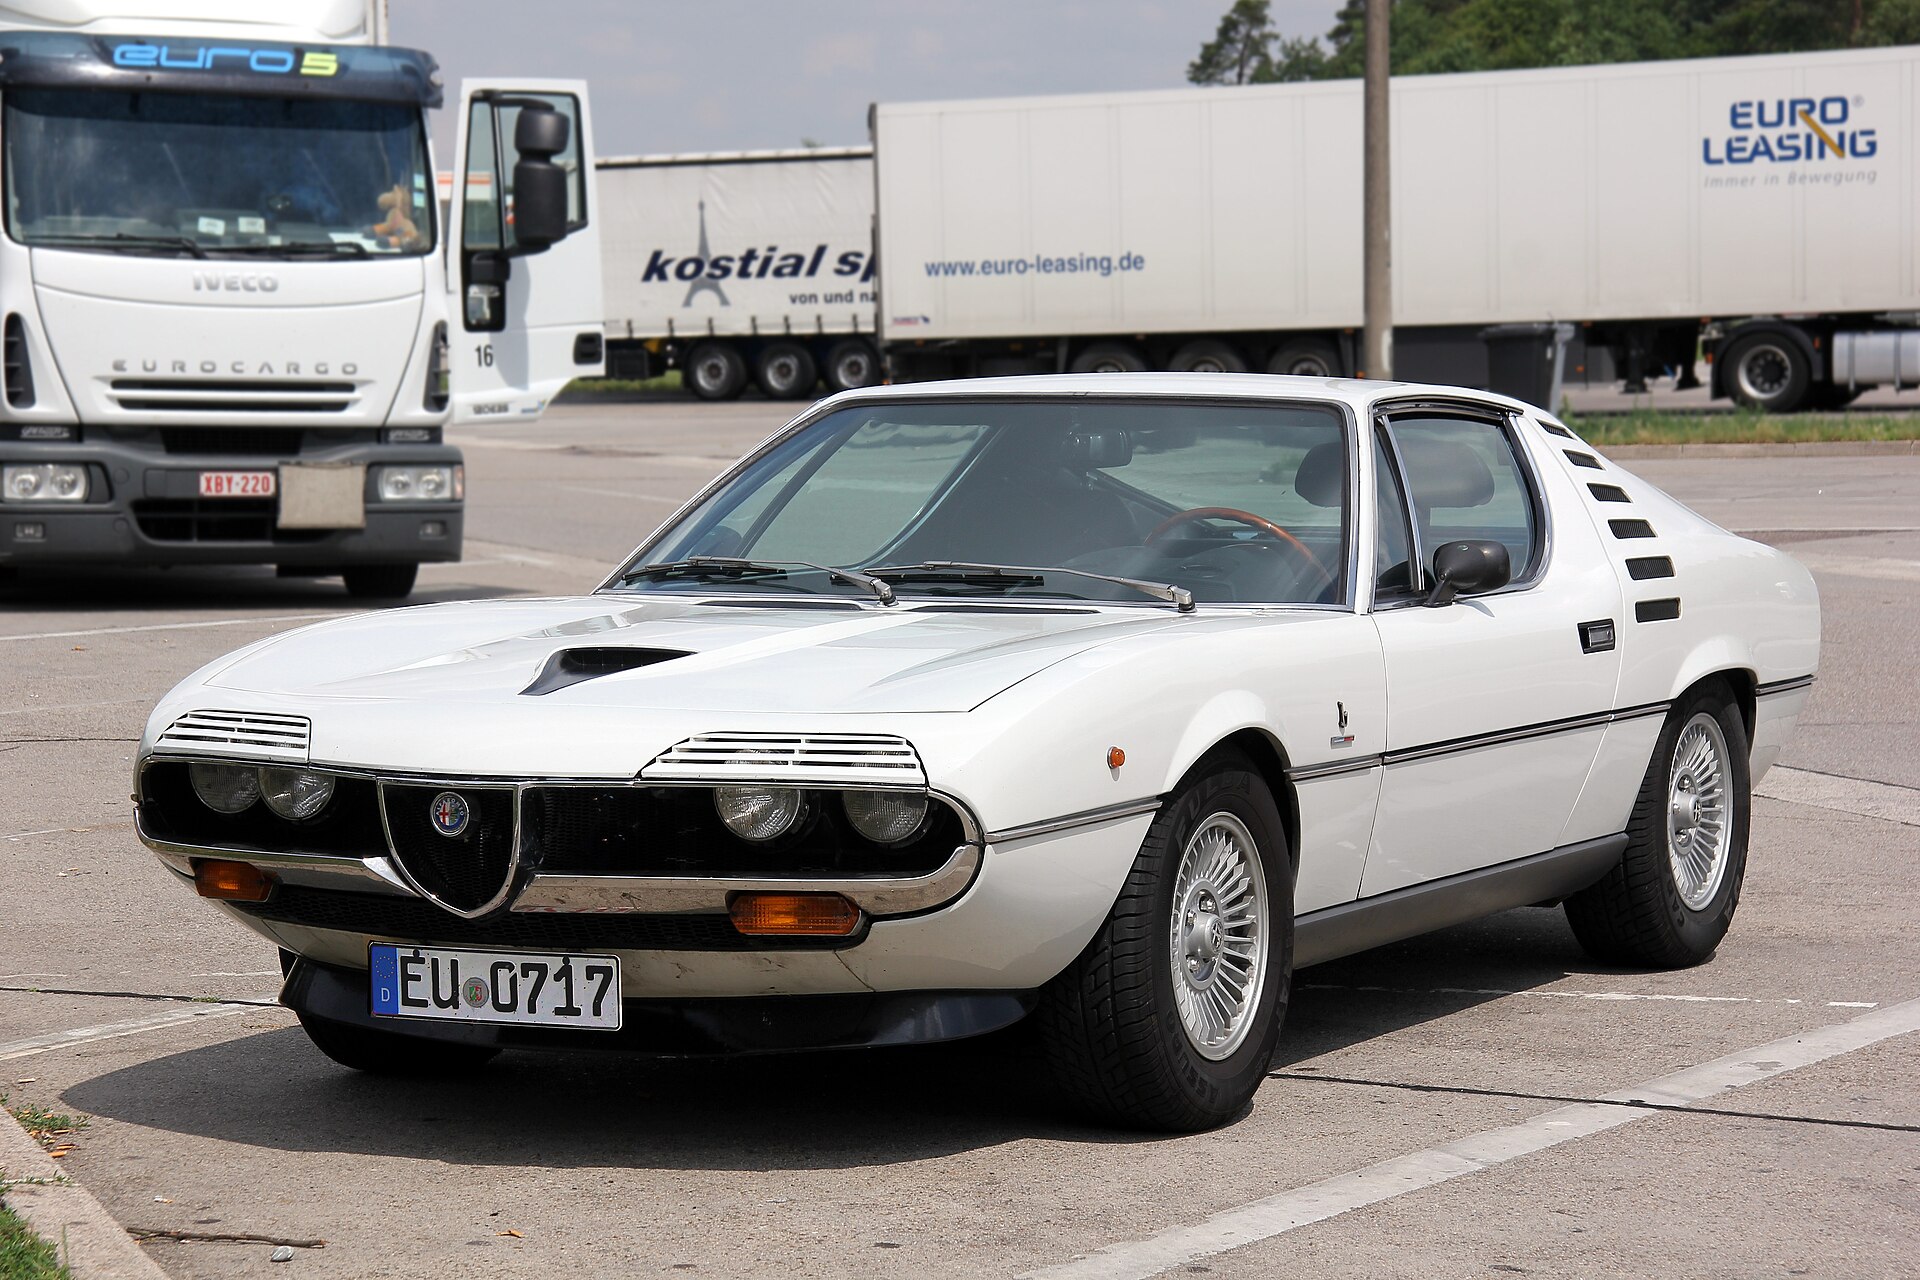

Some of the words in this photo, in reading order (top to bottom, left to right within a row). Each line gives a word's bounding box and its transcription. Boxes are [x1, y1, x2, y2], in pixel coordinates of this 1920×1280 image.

[113, 44, 294, 73] euro
[300, 51, 338, 77] 5
[1730, 96, 1849, 130] EURO
[1703, 129, 1878, 165] LEASING
[1704, 175, 1756, 189] Immer
[1764, 172, 1779, 186] in
[1788, 169, 1878, 186] Bewegung
[642, 244, 828, 283] kostial
[925, 252, 1145, 277] www.euro-leasing.de
[193, 271, 279, 293] IVECO
[789, 292, 818, 305] von
[824, 290, 853, 304] und
[112, 359, 358, 375] EUROCARGO
[475, 344, 494, 368] 16
[381, 988, 391, 1003] D
[490, 960, 614, 1018] 0717
